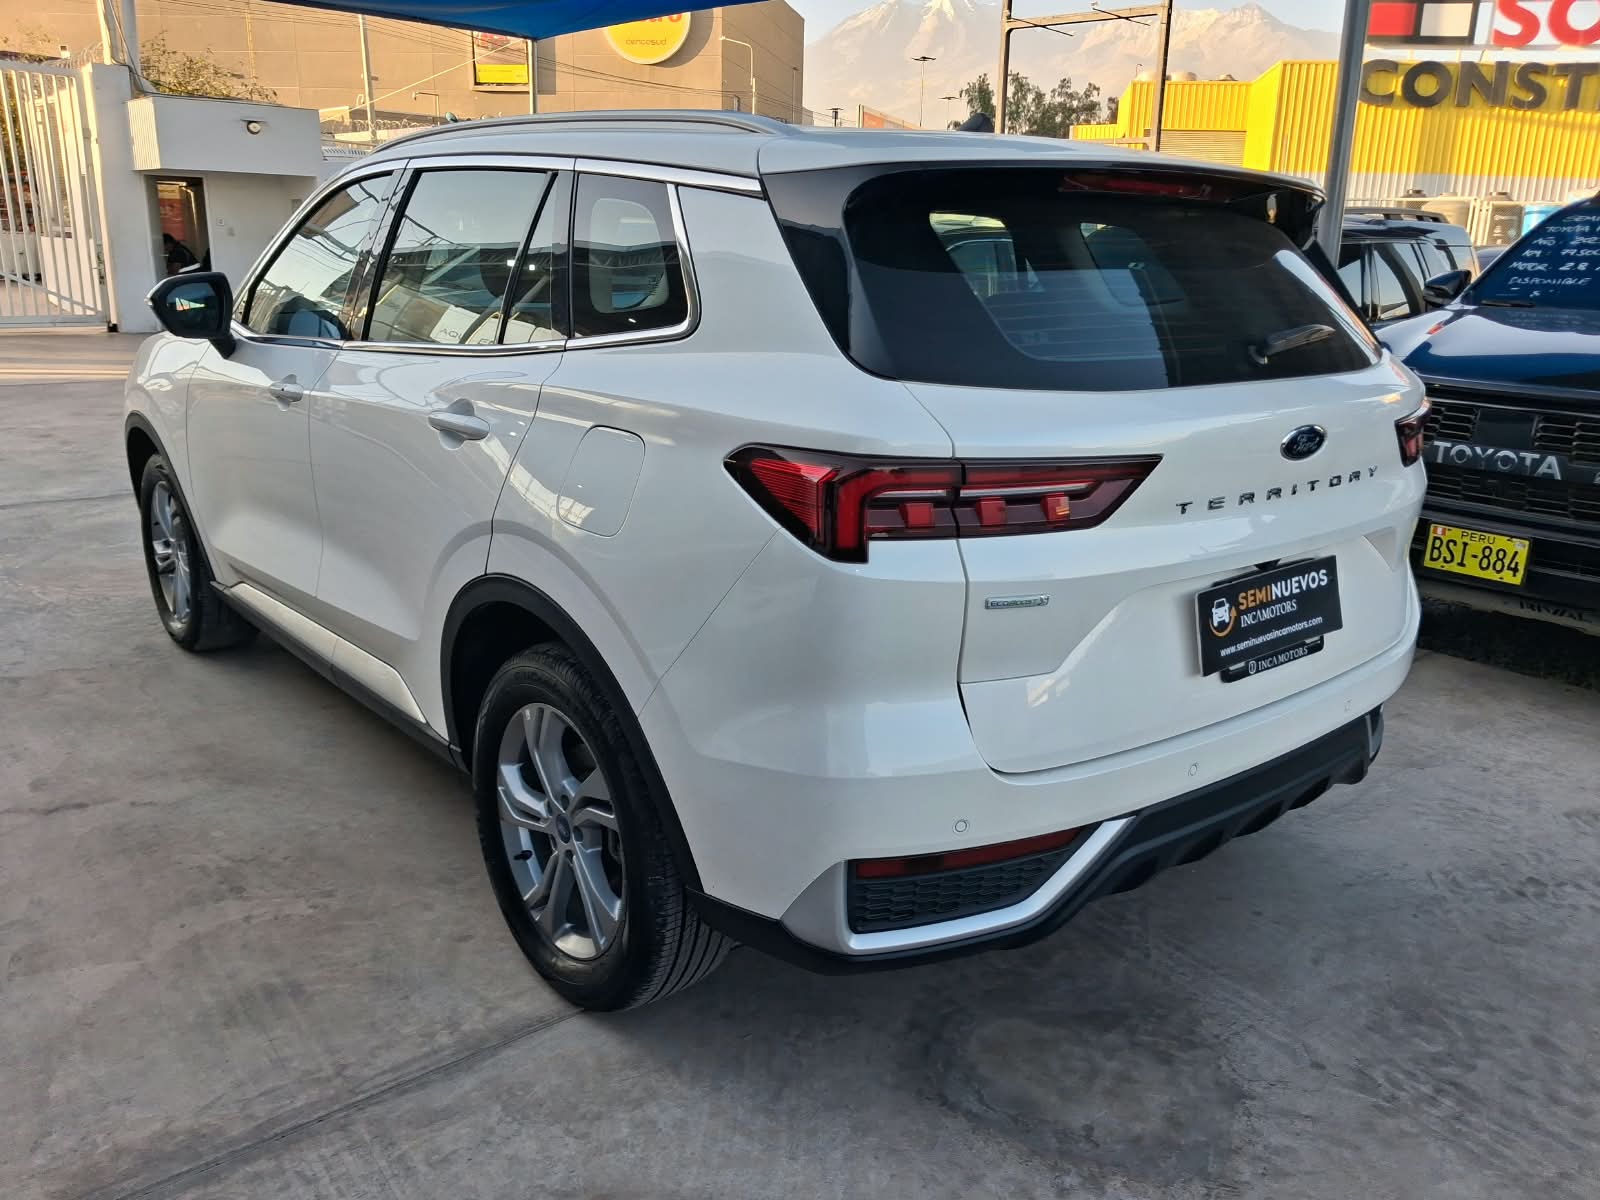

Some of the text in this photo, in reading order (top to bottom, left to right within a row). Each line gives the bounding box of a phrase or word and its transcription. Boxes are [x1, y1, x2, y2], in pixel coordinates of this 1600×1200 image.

[625, 37, 667, 46] cencosud
[1433, 440, 1562, 481] TOYOTA
[1175, 464, 1379, 516] TERRITORY
[1428, 535, 1521, 578] BSI-884
[1460, 530, 1497, 545] PERU
[1238, 568, 1329, 611] SEMINUEVOS
[1240, 599, 1298, 628] INCAMOTORS
[1220, 616, 1323, 657] www.seminuevosincamotors.com
